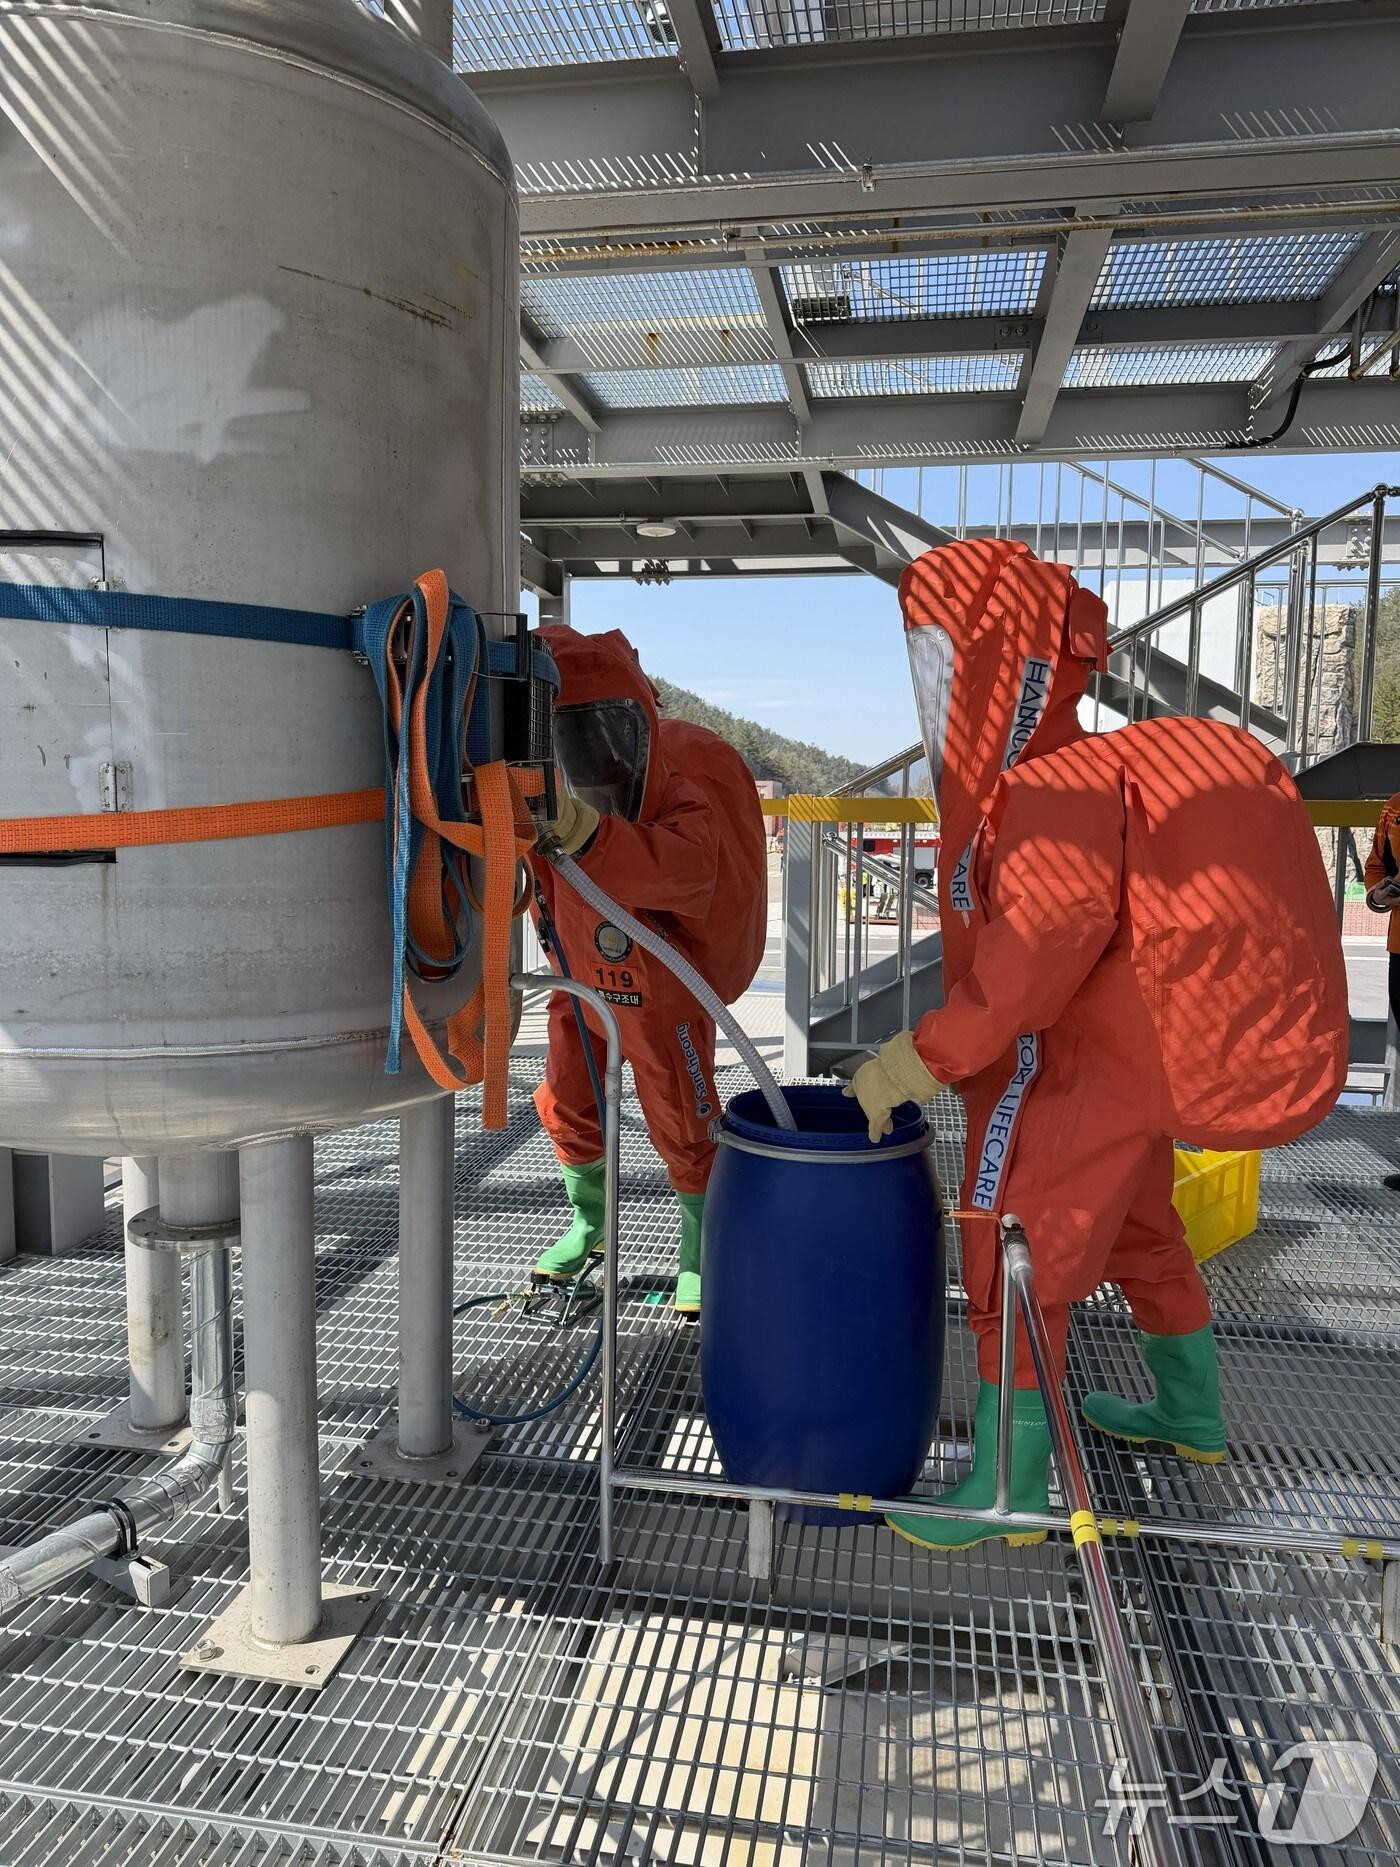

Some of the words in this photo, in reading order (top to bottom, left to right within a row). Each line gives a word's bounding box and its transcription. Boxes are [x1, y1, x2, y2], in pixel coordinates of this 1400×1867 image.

[596, 967, 634, 988] 119
[677, 1023, 707, 1100] Sancheong
[974, 1094, 1020, 1207] LIFECARE
